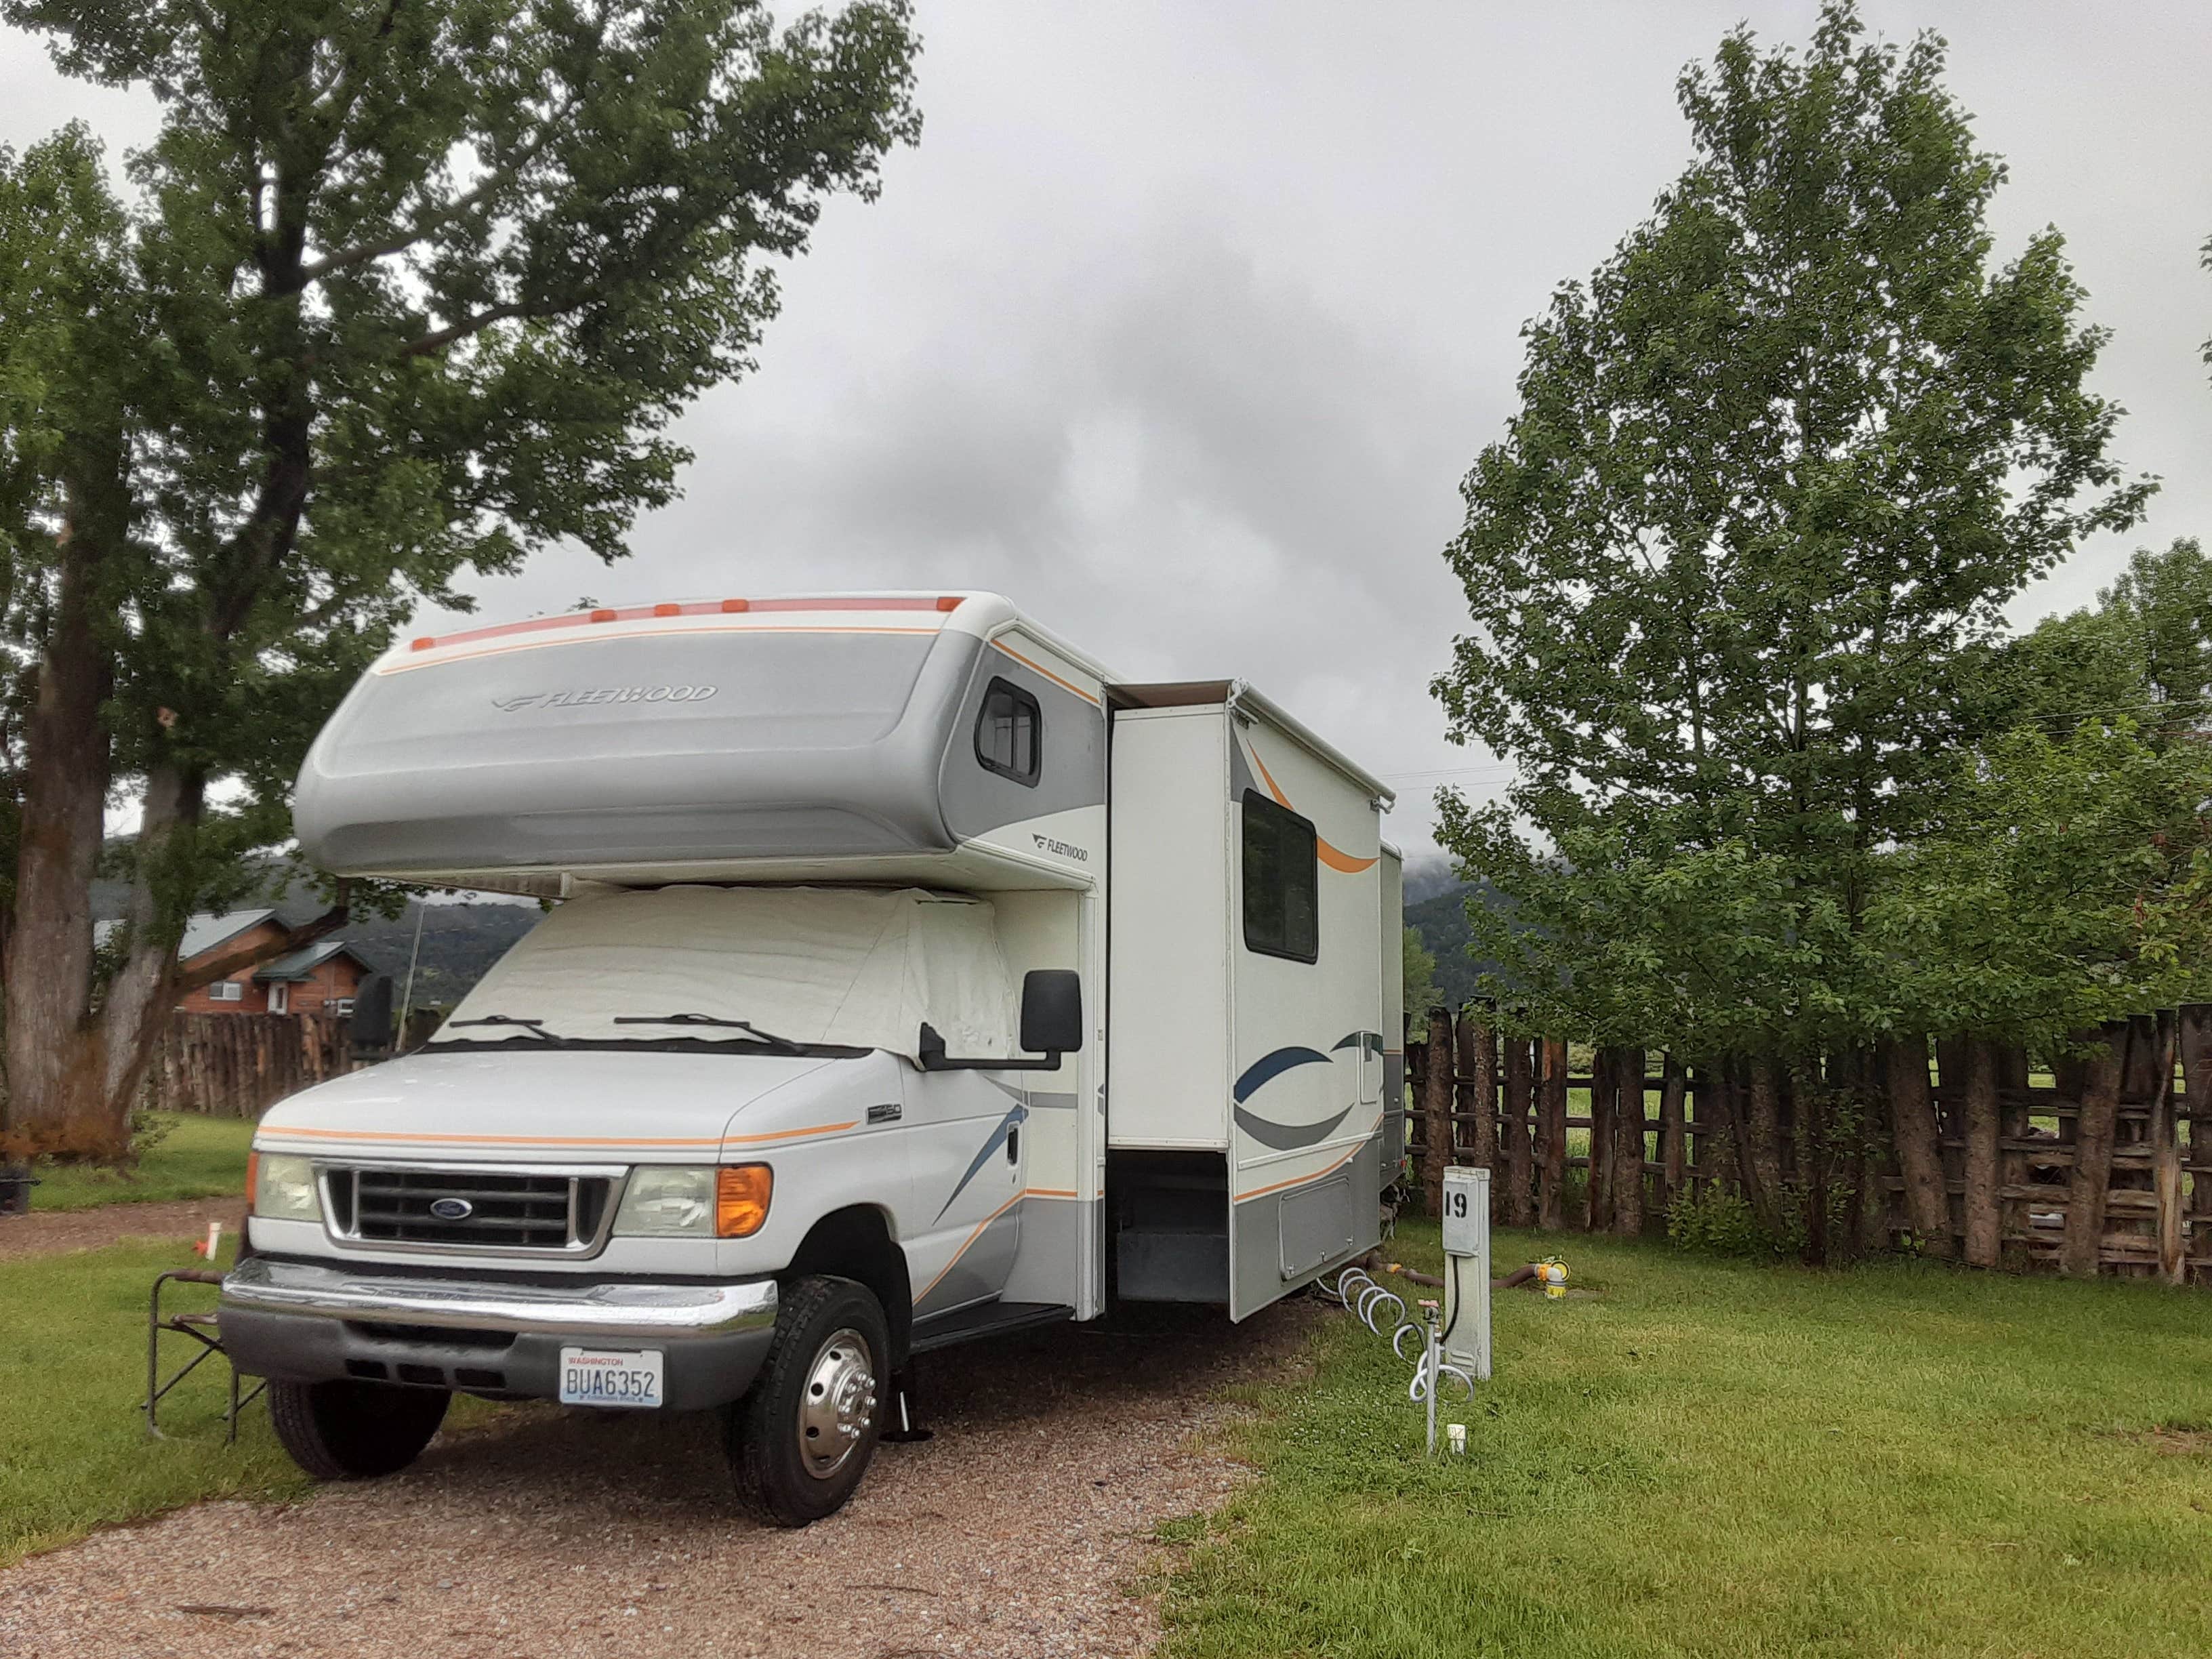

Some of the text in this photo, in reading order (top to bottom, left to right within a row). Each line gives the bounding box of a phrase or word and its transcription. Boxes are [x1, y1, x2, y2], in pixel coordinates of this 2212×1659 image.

[539, 684, 719, 709] FLEETWOOD
[1047, 839, 1088, 862] FLEETWOOD
[1446, 1191, 1467, 1218] 19
[568, 1356, 623, 1366] WASHINGTON
[567, 1368, 655, 1398] BUA6352
